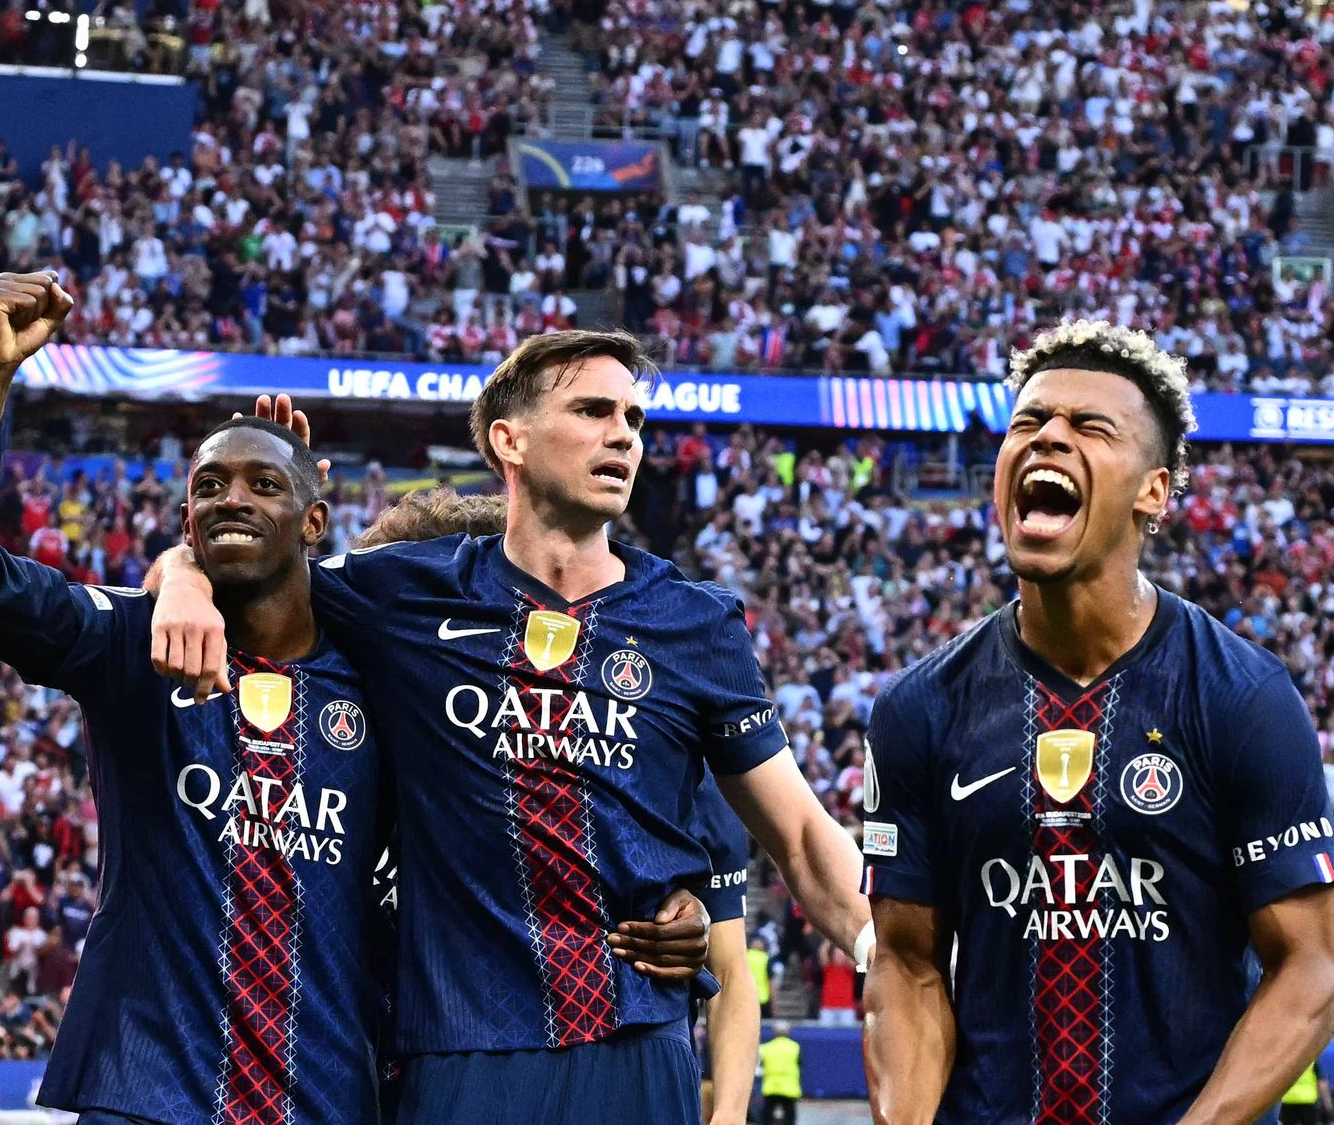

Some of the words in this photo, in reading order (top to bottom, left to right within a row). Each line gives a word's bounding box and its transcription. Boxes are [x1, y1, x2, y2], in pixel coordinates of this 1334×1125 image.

[328, 369, 411, 398] UEFA
[417, 372, 489, 400] CHA
[635, 381, 741, 413] EAGUE
[612, 652, 646, 669] PARIS
[327, 702, 360, 717] PARIS
[446, 685, 637, 740] QATAR
[493, 732, 634, 770] AIRWAYS
[1132, 757, 1174, 773] PARIS
[177, 763, 346, 835] QATAR
[218, 820, 343, 866] AIRWAYS
[867, 833, 896, 847] ATION
[1232, 817, 1333, 867] BEYOND
[710, 868, 747, 889] EYO
[981, 854, 1168, 919] QATAR
[1024, 909, 1169, 943] AIRWAYS
